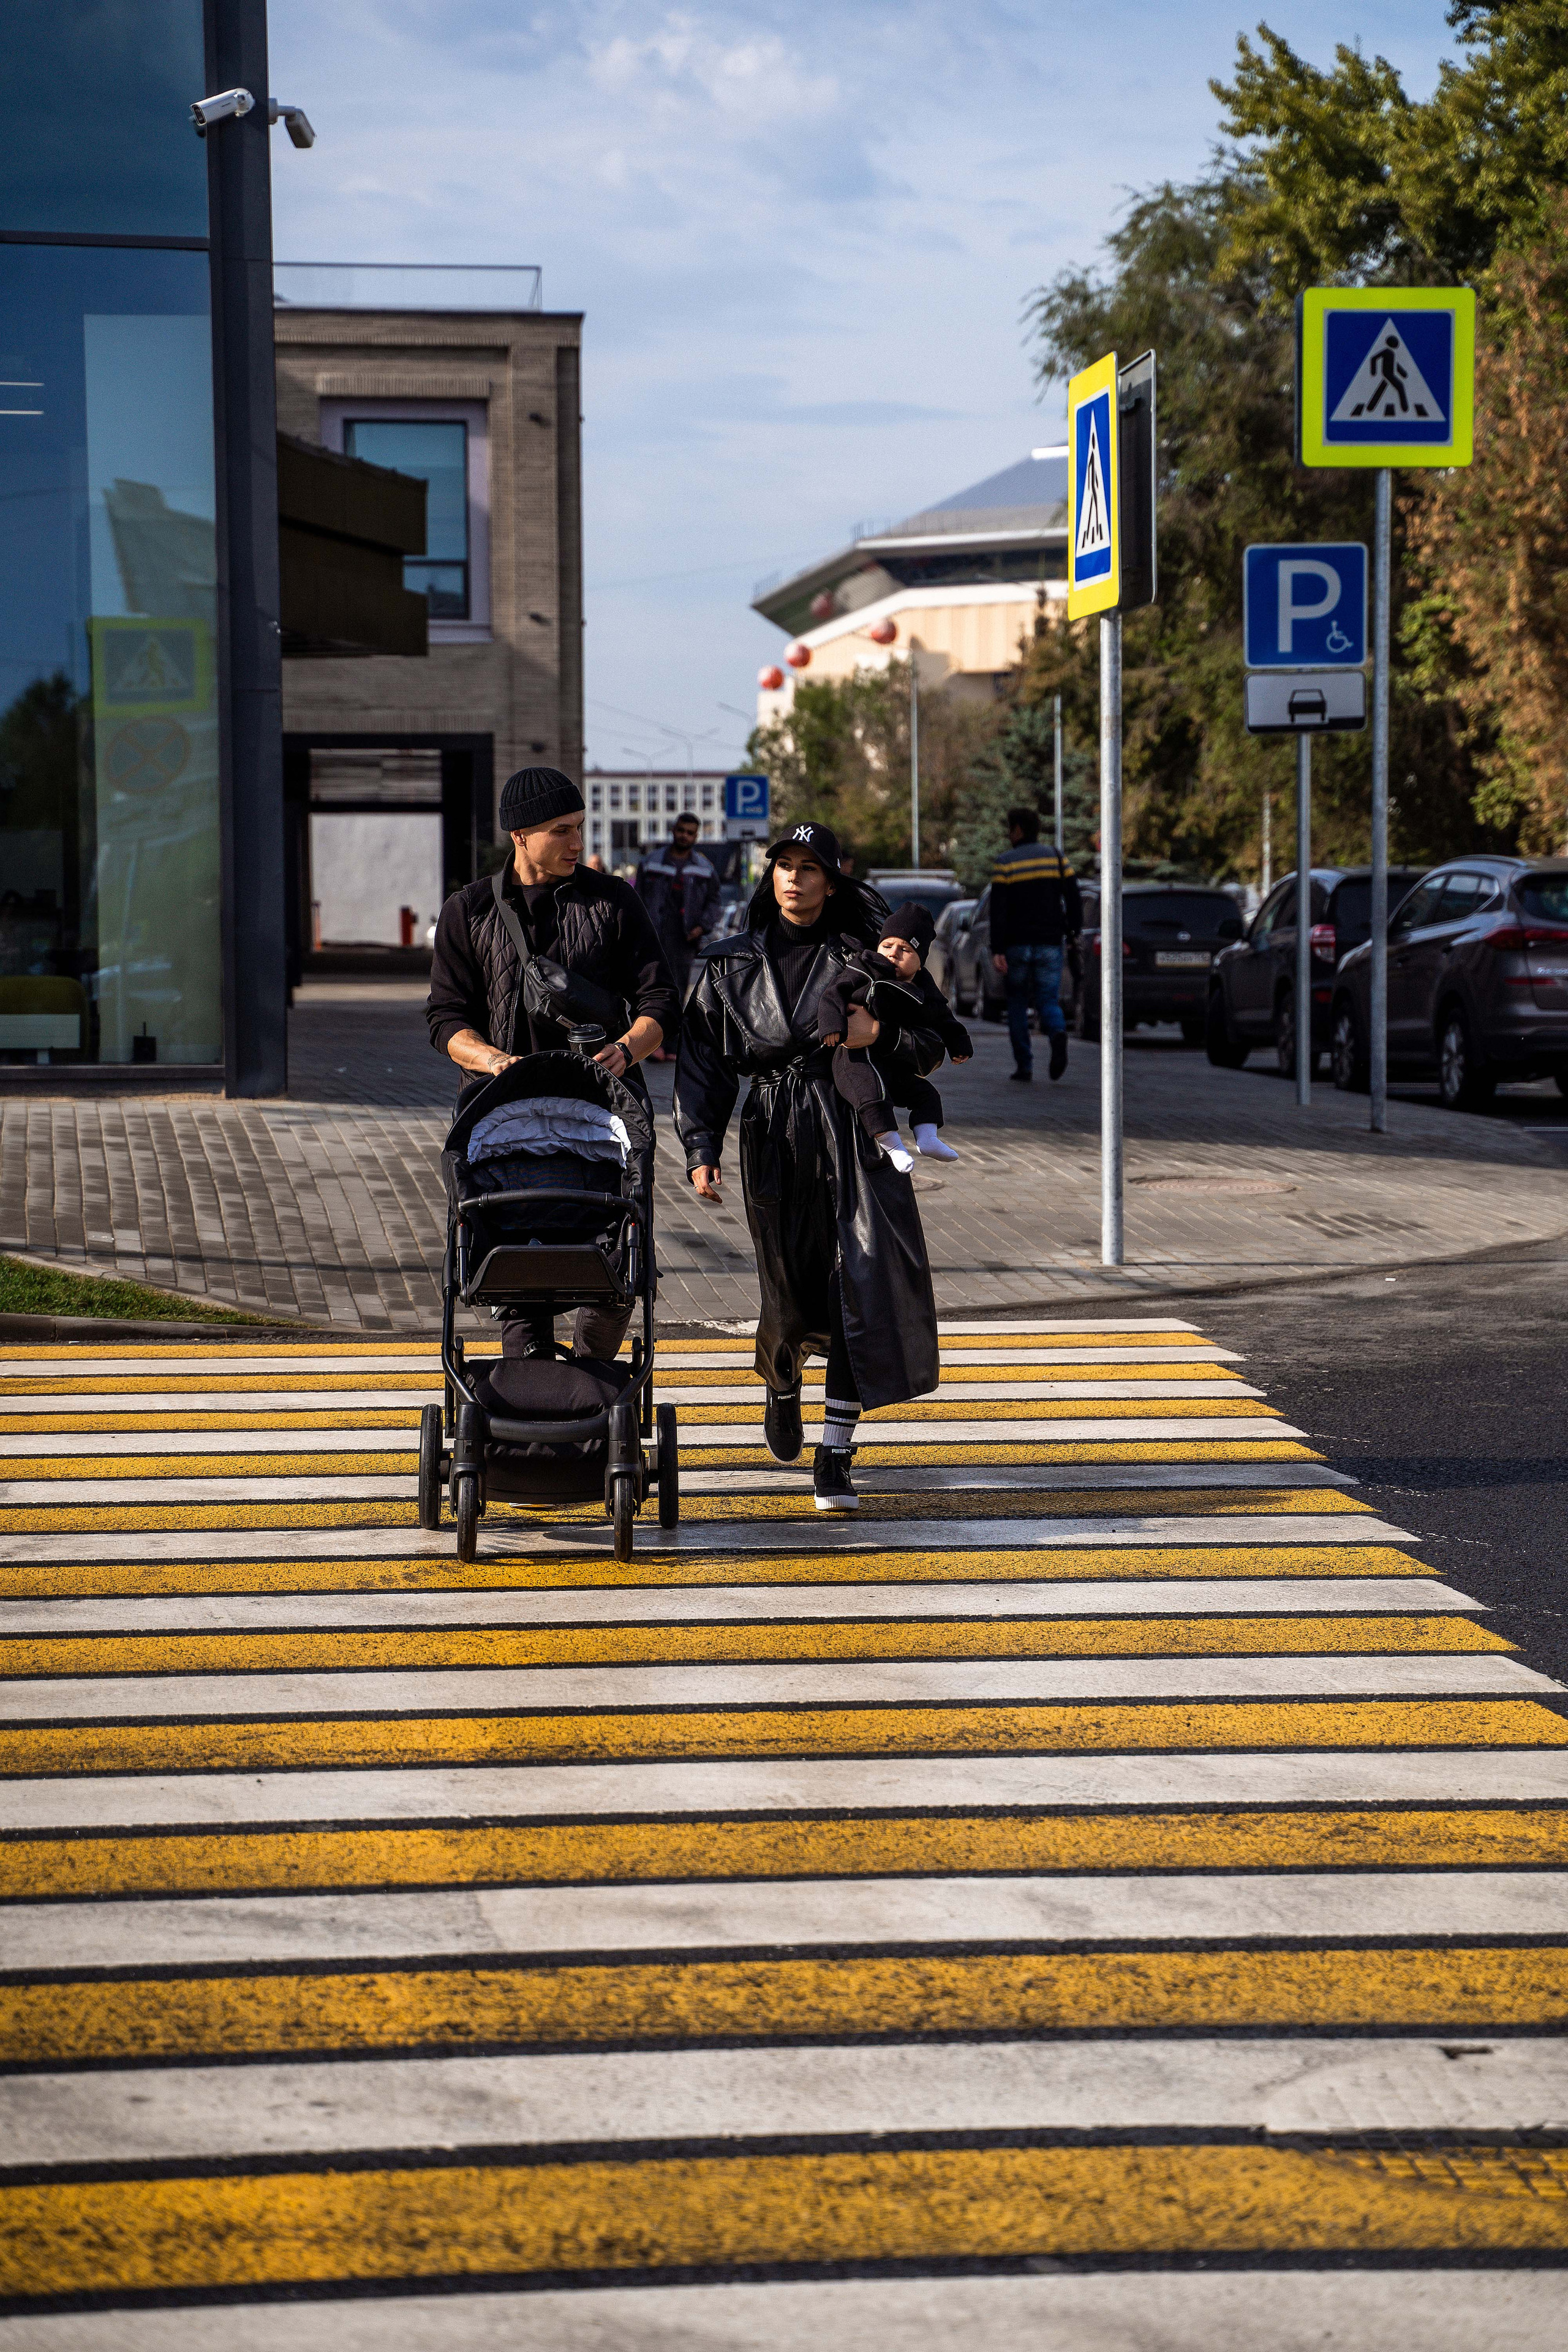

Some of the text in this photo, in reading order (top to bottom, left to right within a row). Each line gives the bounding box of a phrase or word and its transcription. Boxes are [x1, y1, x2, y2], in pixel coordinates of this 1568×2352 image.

[1278, 559, 1341, 653] P
[737, 780, 760, 814] P
[792, 825, 813, 842] NY
